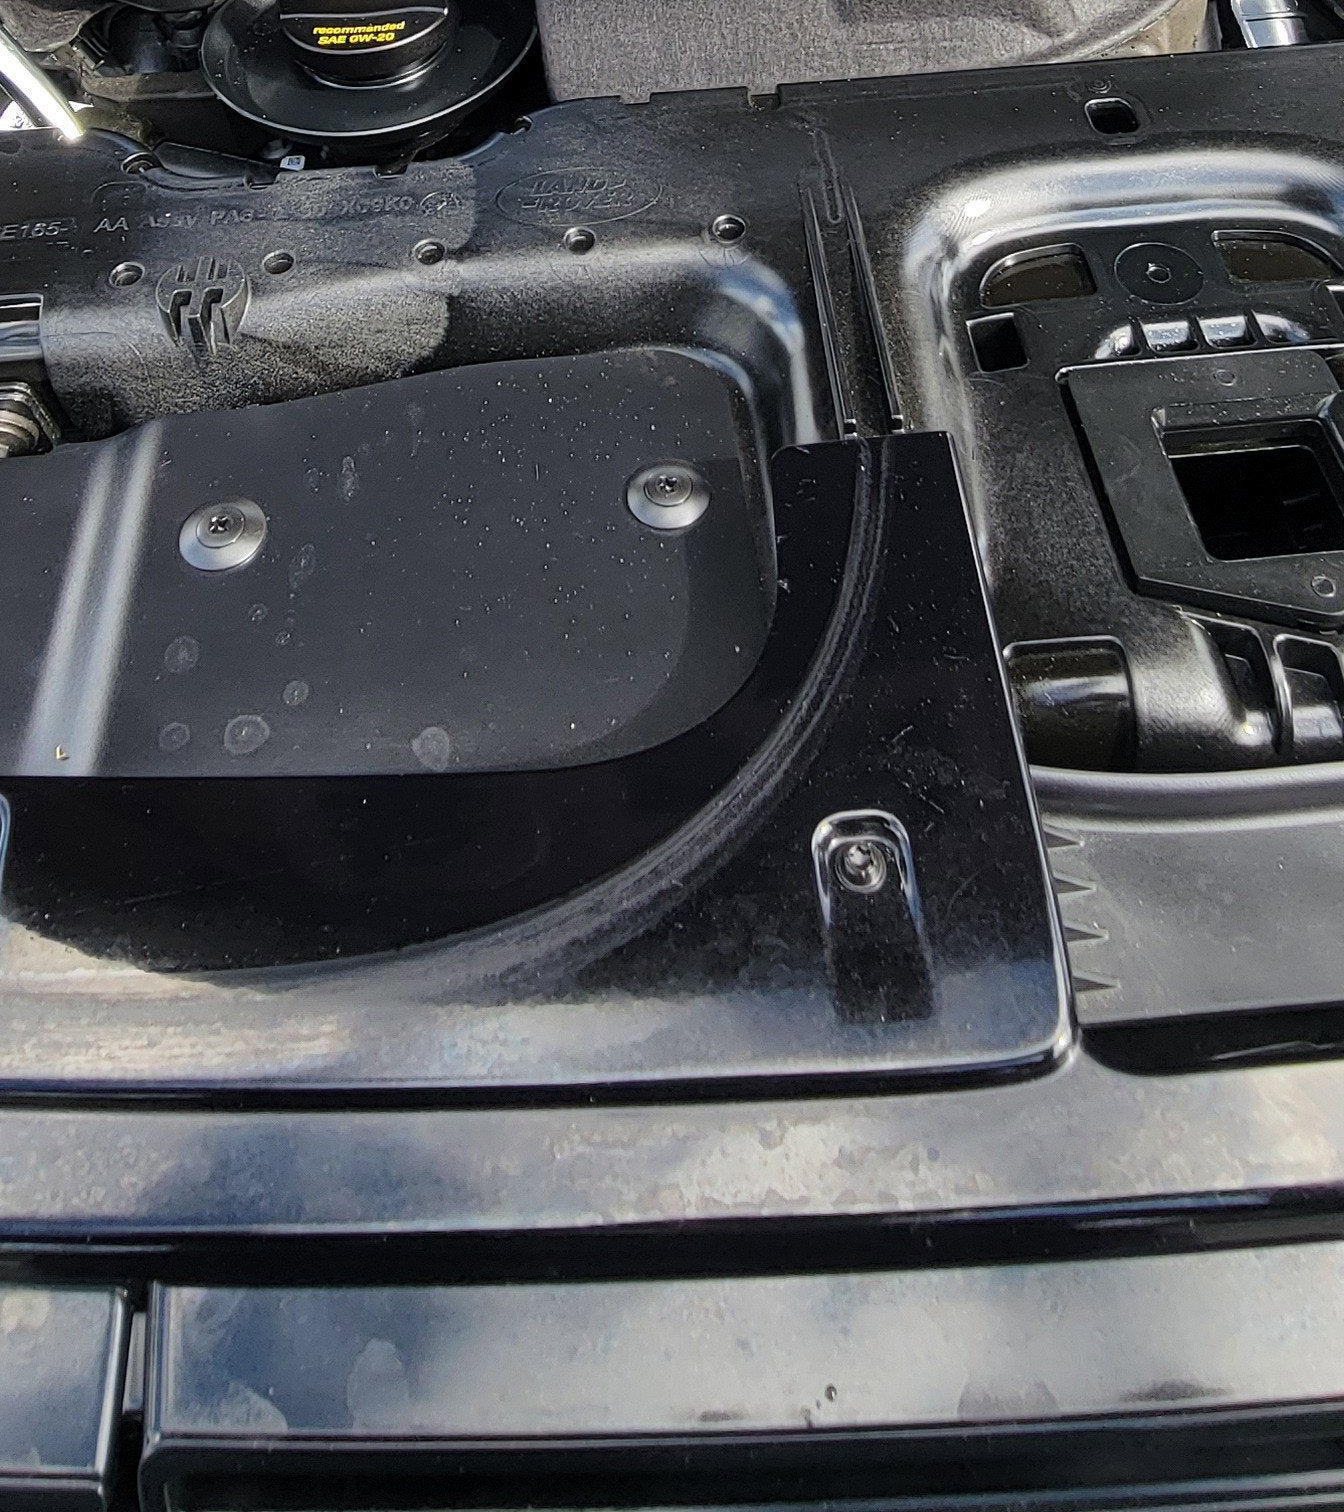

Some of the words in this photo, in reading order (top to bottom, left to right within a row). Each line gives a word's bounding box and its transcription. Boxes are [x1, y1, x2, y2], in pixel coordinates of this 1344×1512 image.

[312, 20, 406, 35] recommended
[317, 35, 347, 46] SAE
[349, 32, 396, 44] 0W-20
[92, 216, 130, 233] AA
